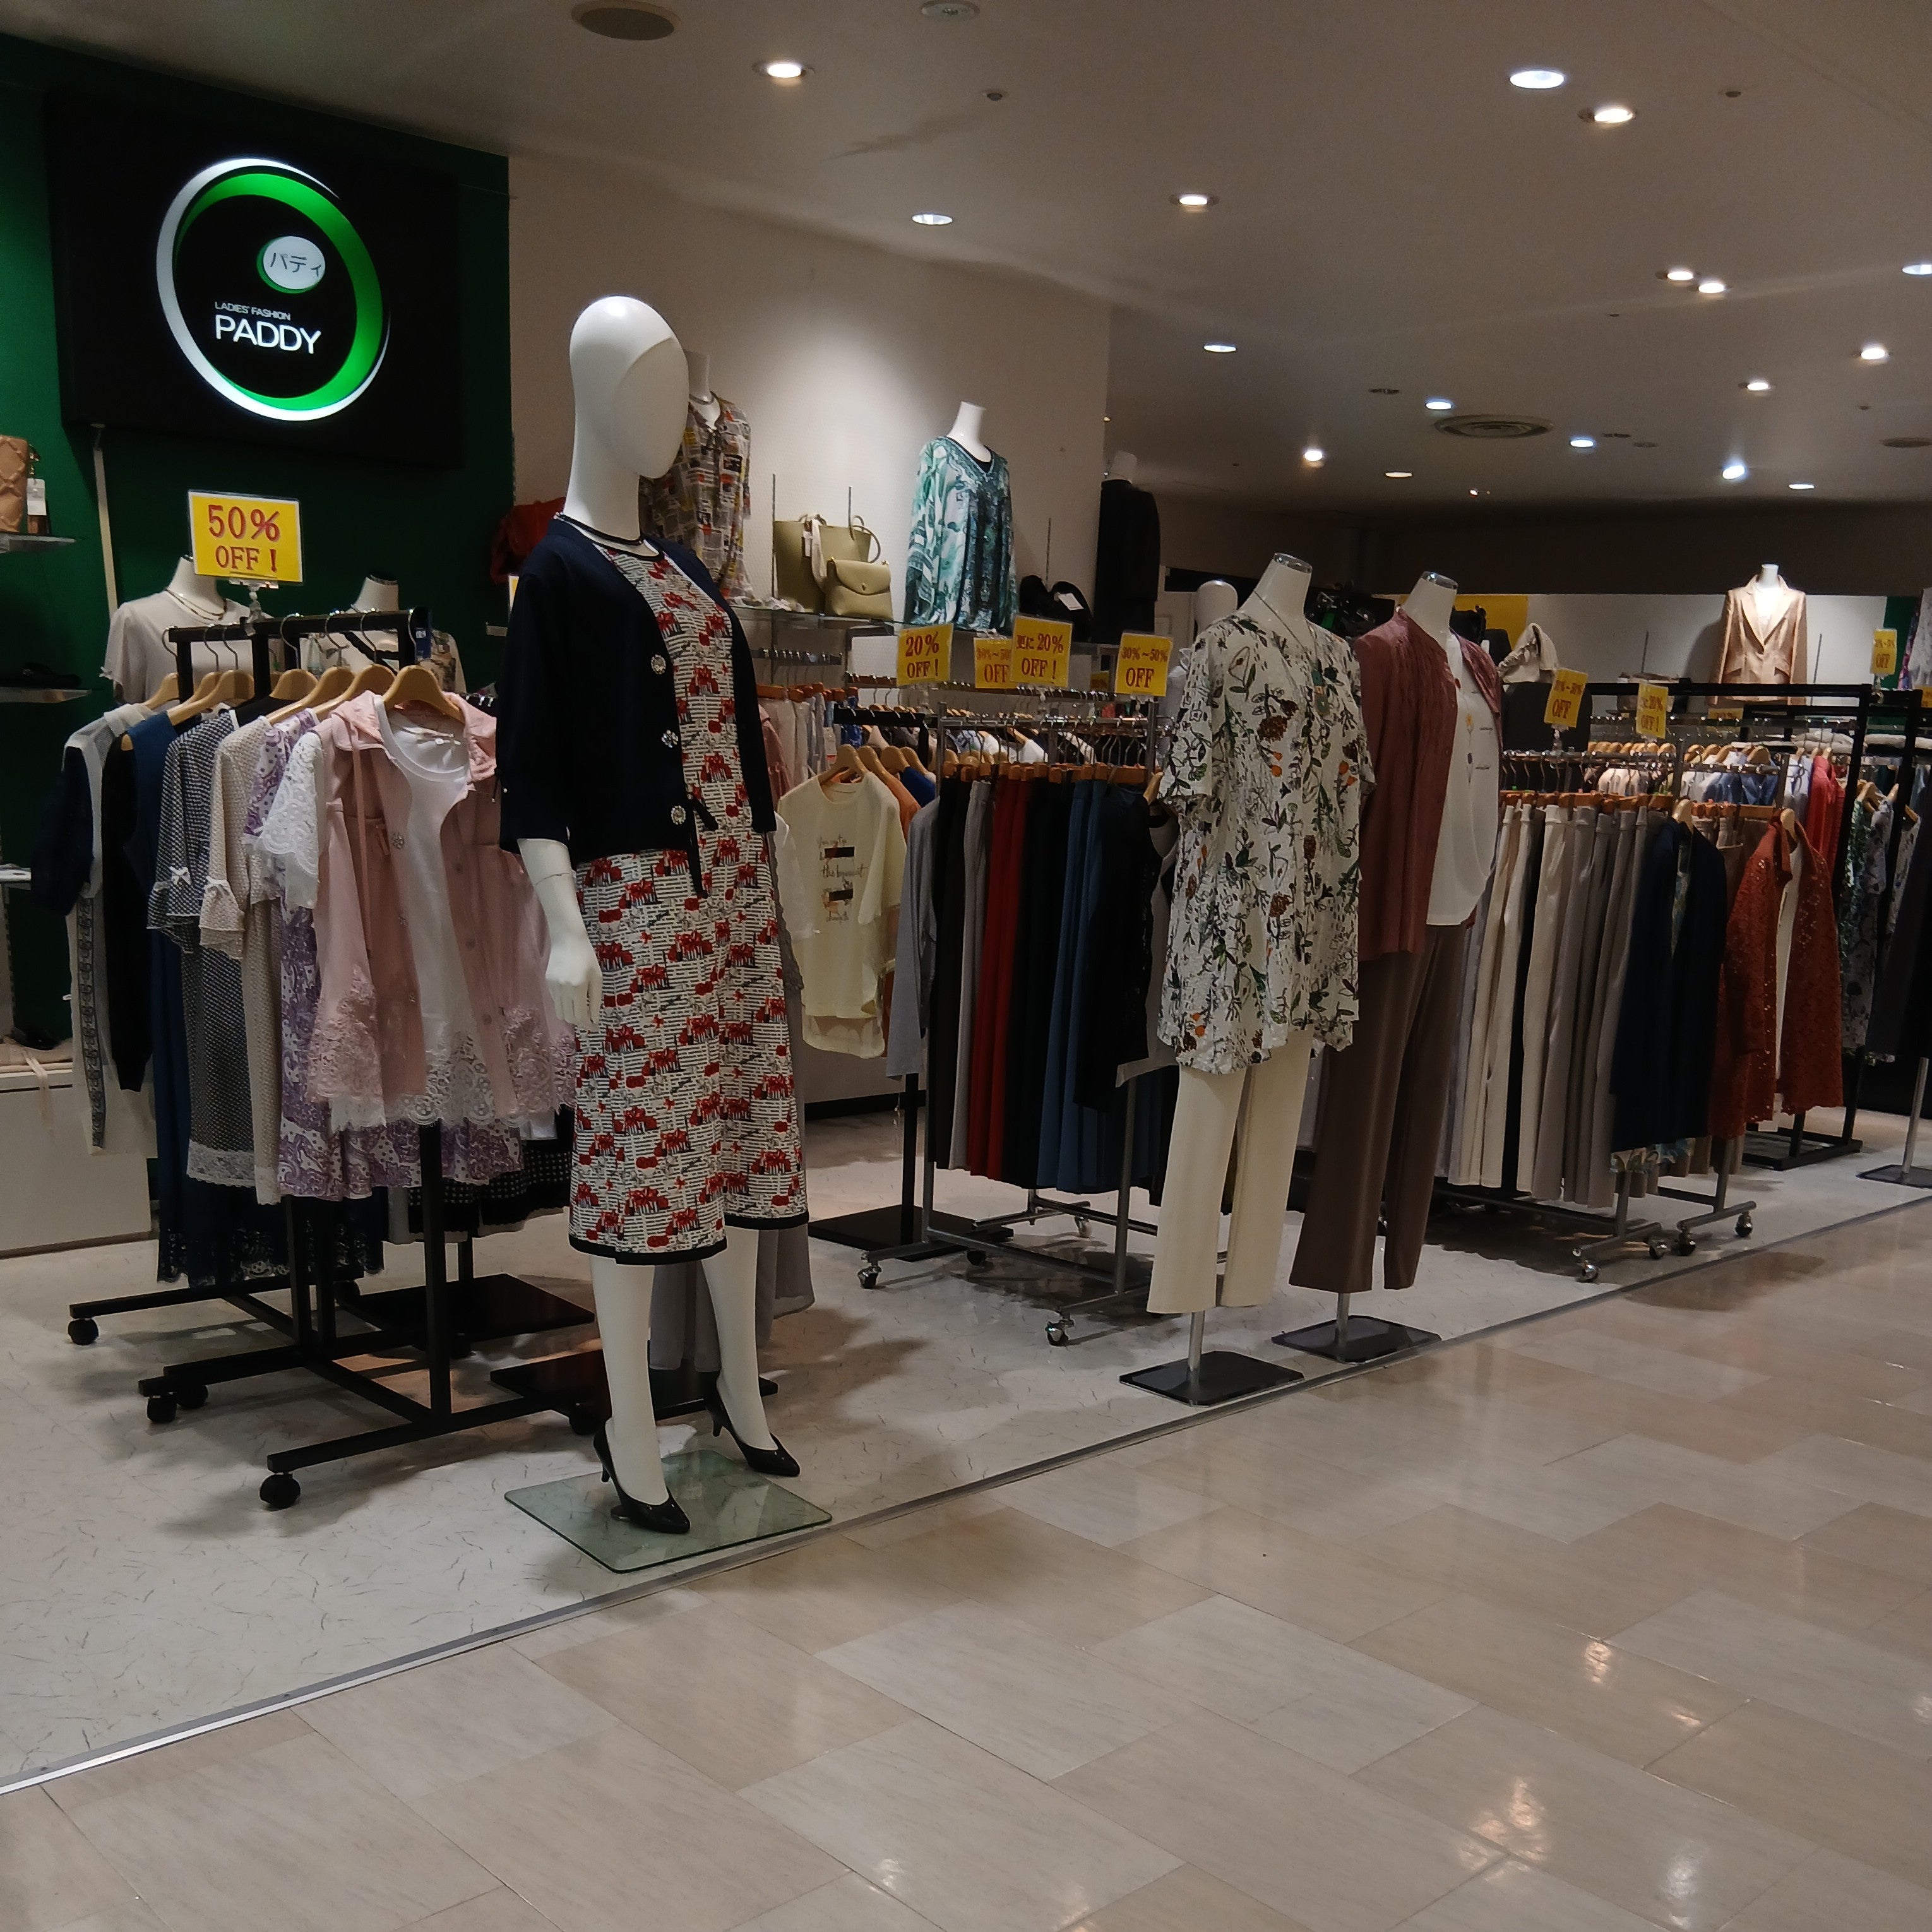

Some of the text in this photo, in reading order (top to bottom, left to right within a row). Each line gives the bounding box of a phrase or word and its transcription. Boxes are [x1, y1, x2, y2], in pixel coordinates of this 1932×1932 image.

[251, 306, 291, 321] FASHION
[215, 314, 321, 354] PADDY
[208, 504, 280, 542] 50%
[905, 631, 940, 657] 20%
[1126, 667, 1154, 688] OFF
[1552, 698, 1572, 719] OFF
